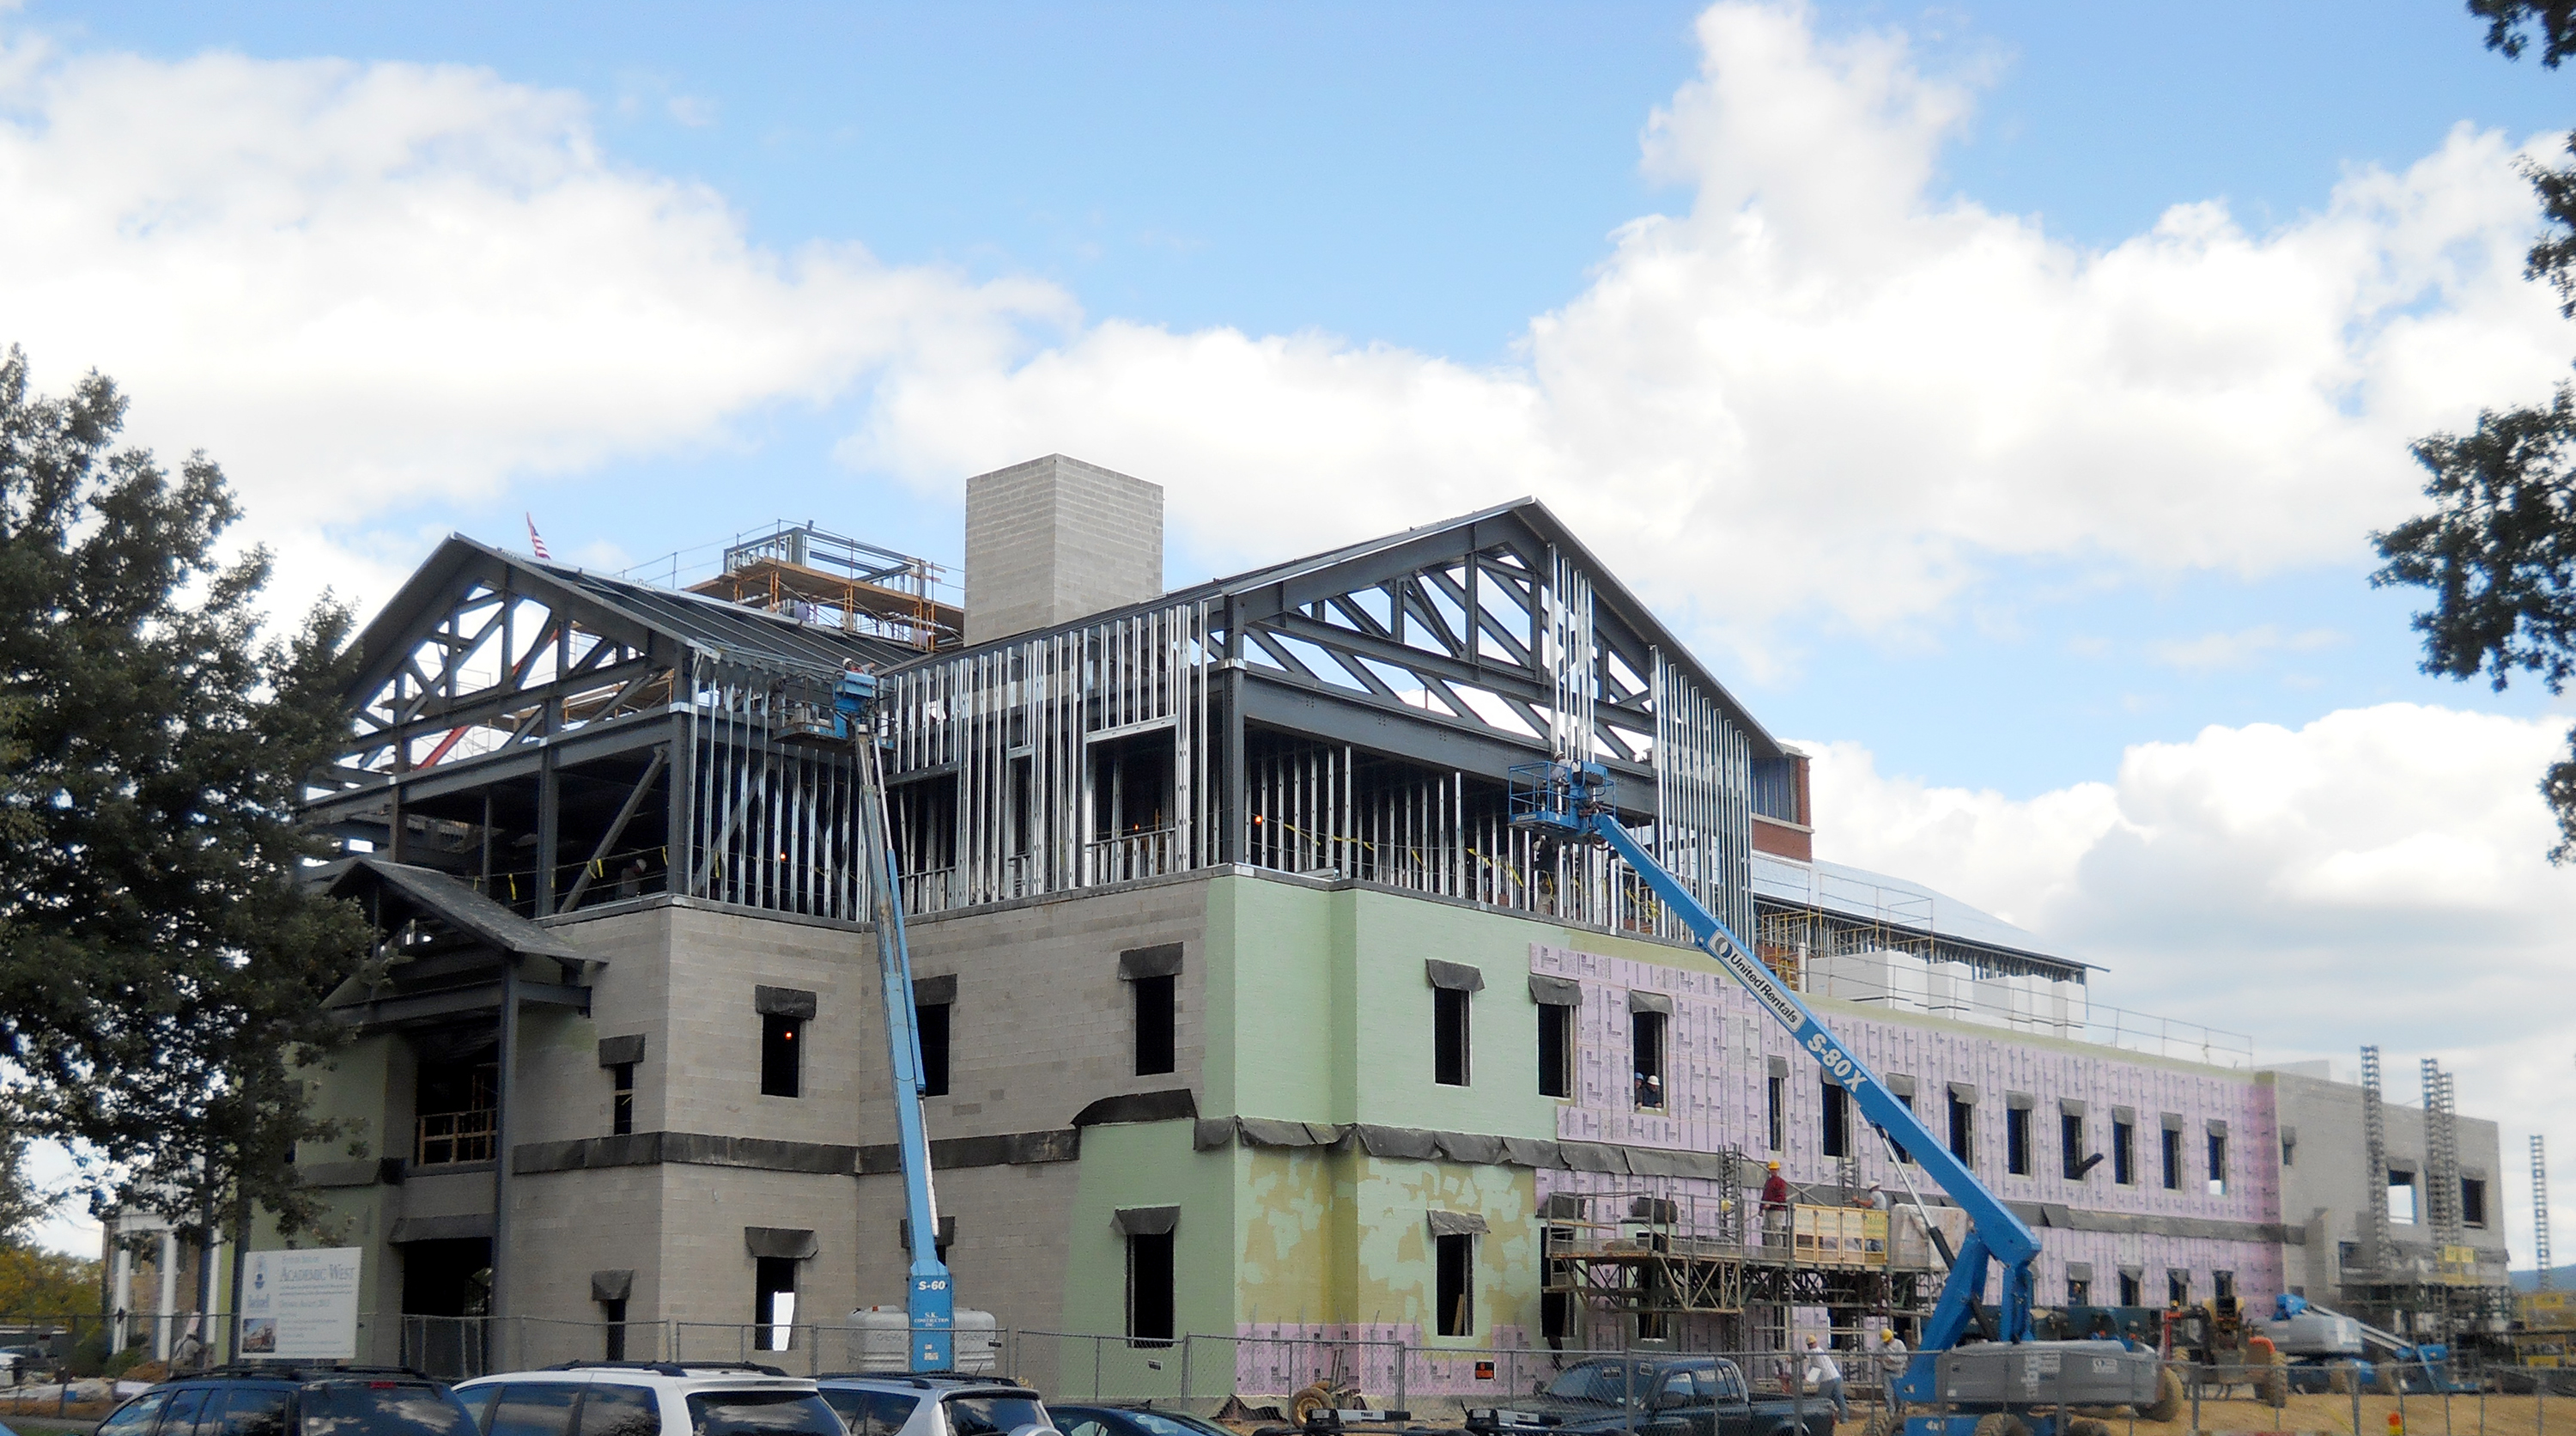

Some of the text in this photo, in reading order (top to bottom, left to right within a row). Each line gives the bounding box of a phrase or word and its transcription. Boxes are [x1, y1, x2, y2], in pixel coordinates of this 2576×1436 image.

[1730, 953, 1797, 1023] United Rentals
[918, 1281, 946, 1291] S-60
